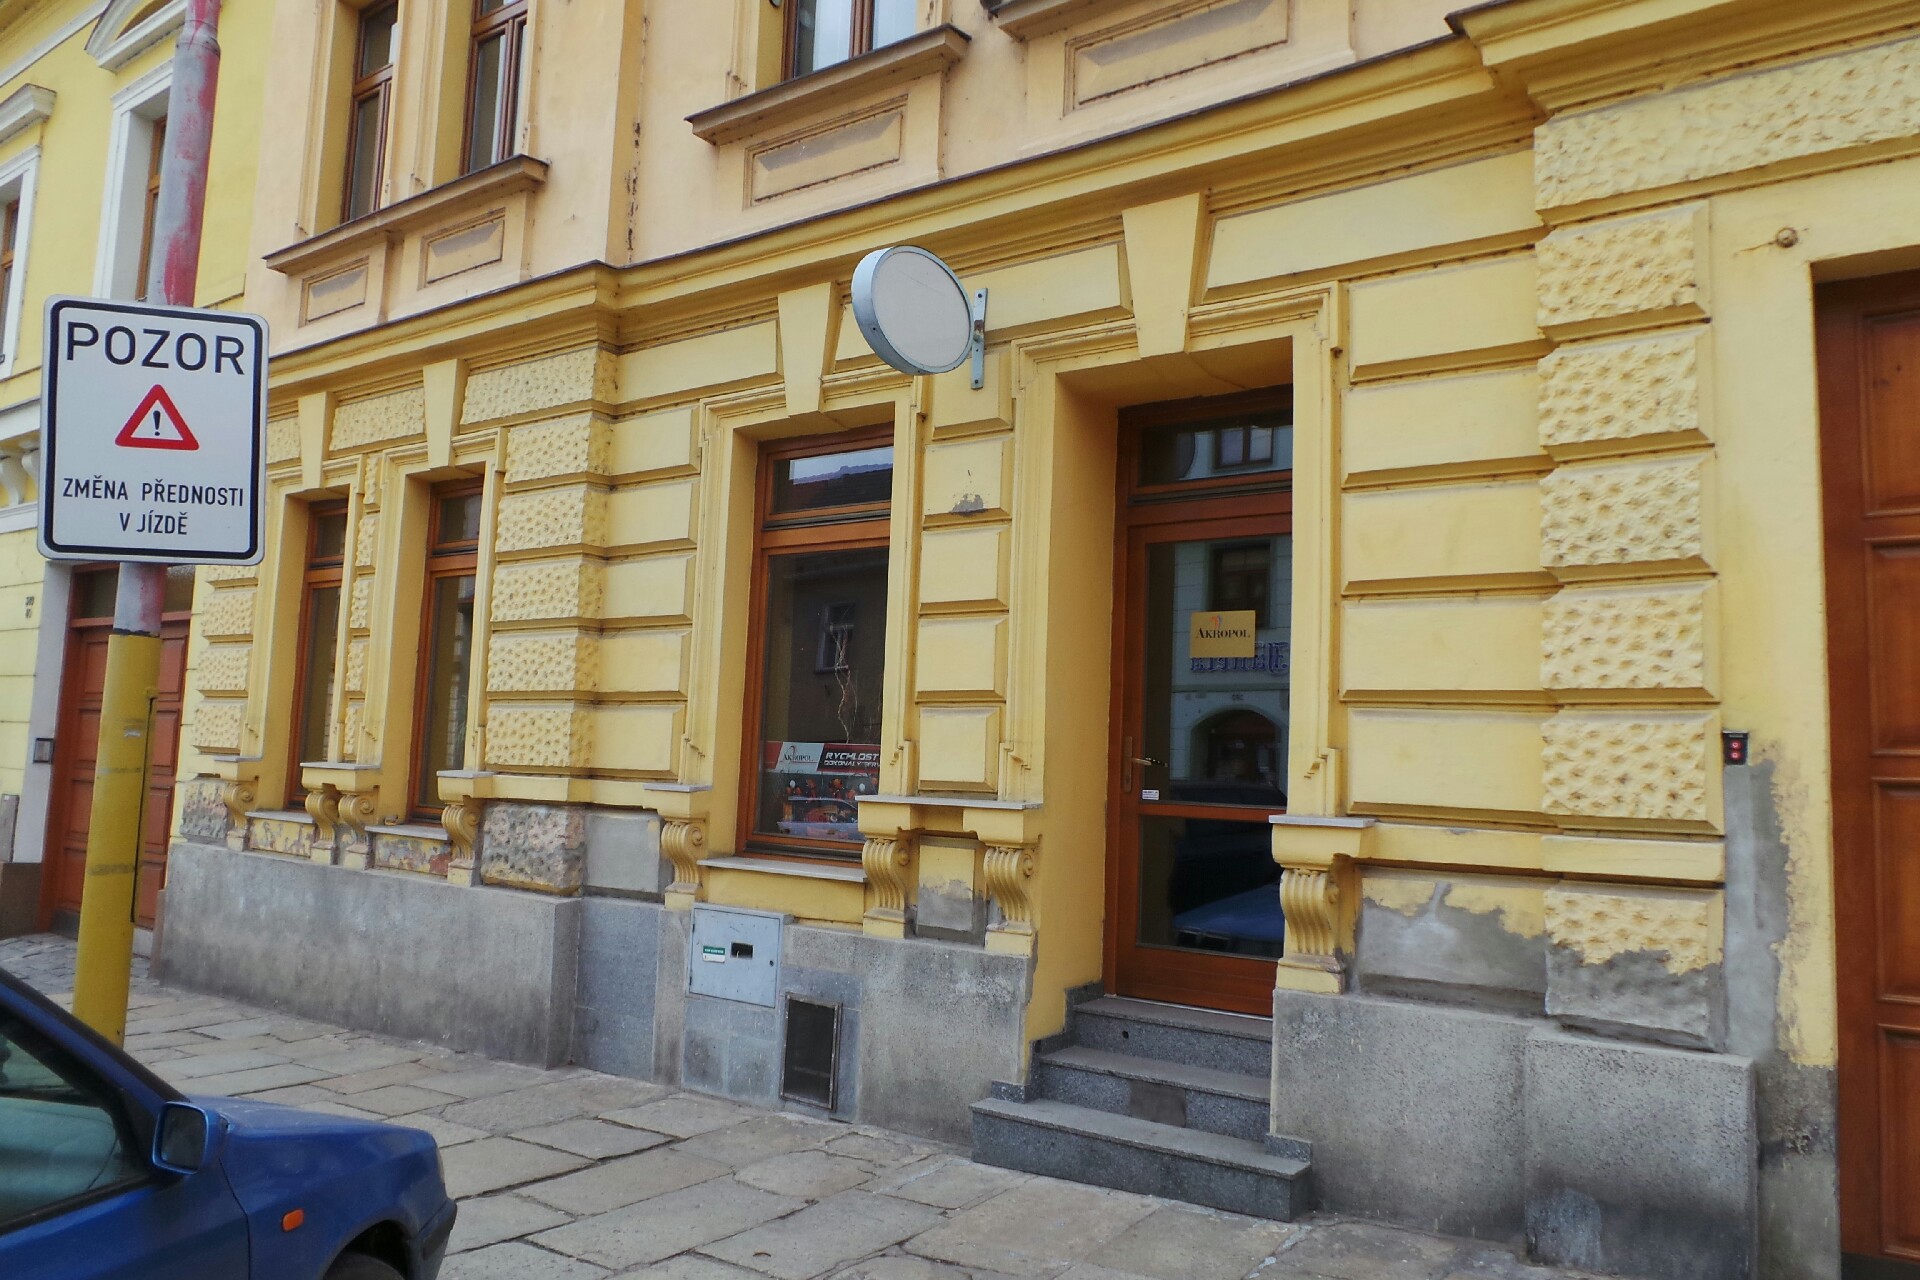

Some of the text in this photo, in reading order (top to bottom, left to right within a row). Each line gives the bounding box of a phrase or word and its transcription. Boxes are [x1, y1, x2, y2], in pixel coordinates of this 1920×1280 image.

[66, 321, 245, 375] POZOR
[62, 475, 244, 507] ZMĚNA PŘEDNOSTI
[119, 510, 188, 535] V JÍZDĚ
[1196, 628, 1251, 639] AKROPOL
